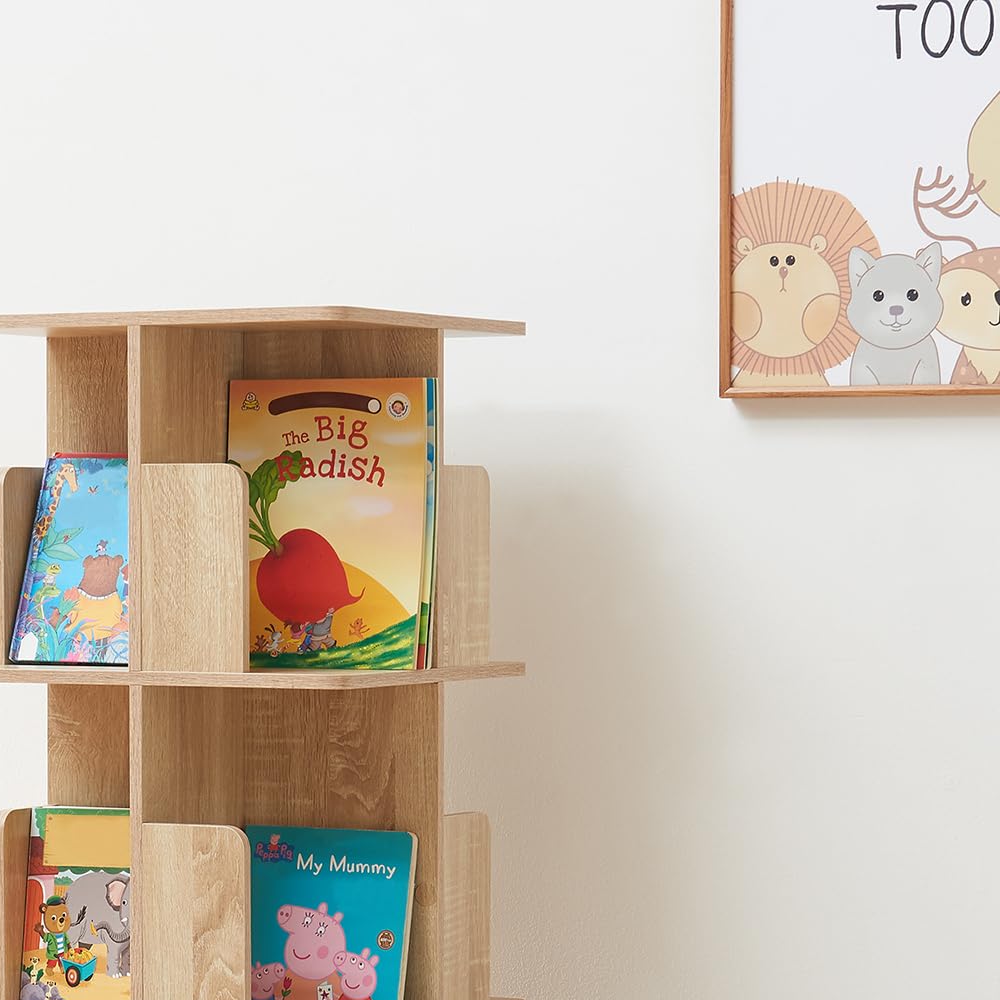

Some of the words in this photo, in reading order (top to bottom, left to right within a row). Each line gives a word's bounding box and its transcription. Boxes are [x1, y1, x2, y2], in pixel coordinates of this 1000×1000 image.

[876, 0, 995, 60] TOO
[282, 430, 310, 447] The
[314, 415, 368, 450] Big
[274, 448, 385, 488] Radish
[255, 842, 280, 861] Peppa
[280, 843, 293, 860] Pig
[296, 853, 323, 876] My
[329, 854, 396, 879] Mummy
